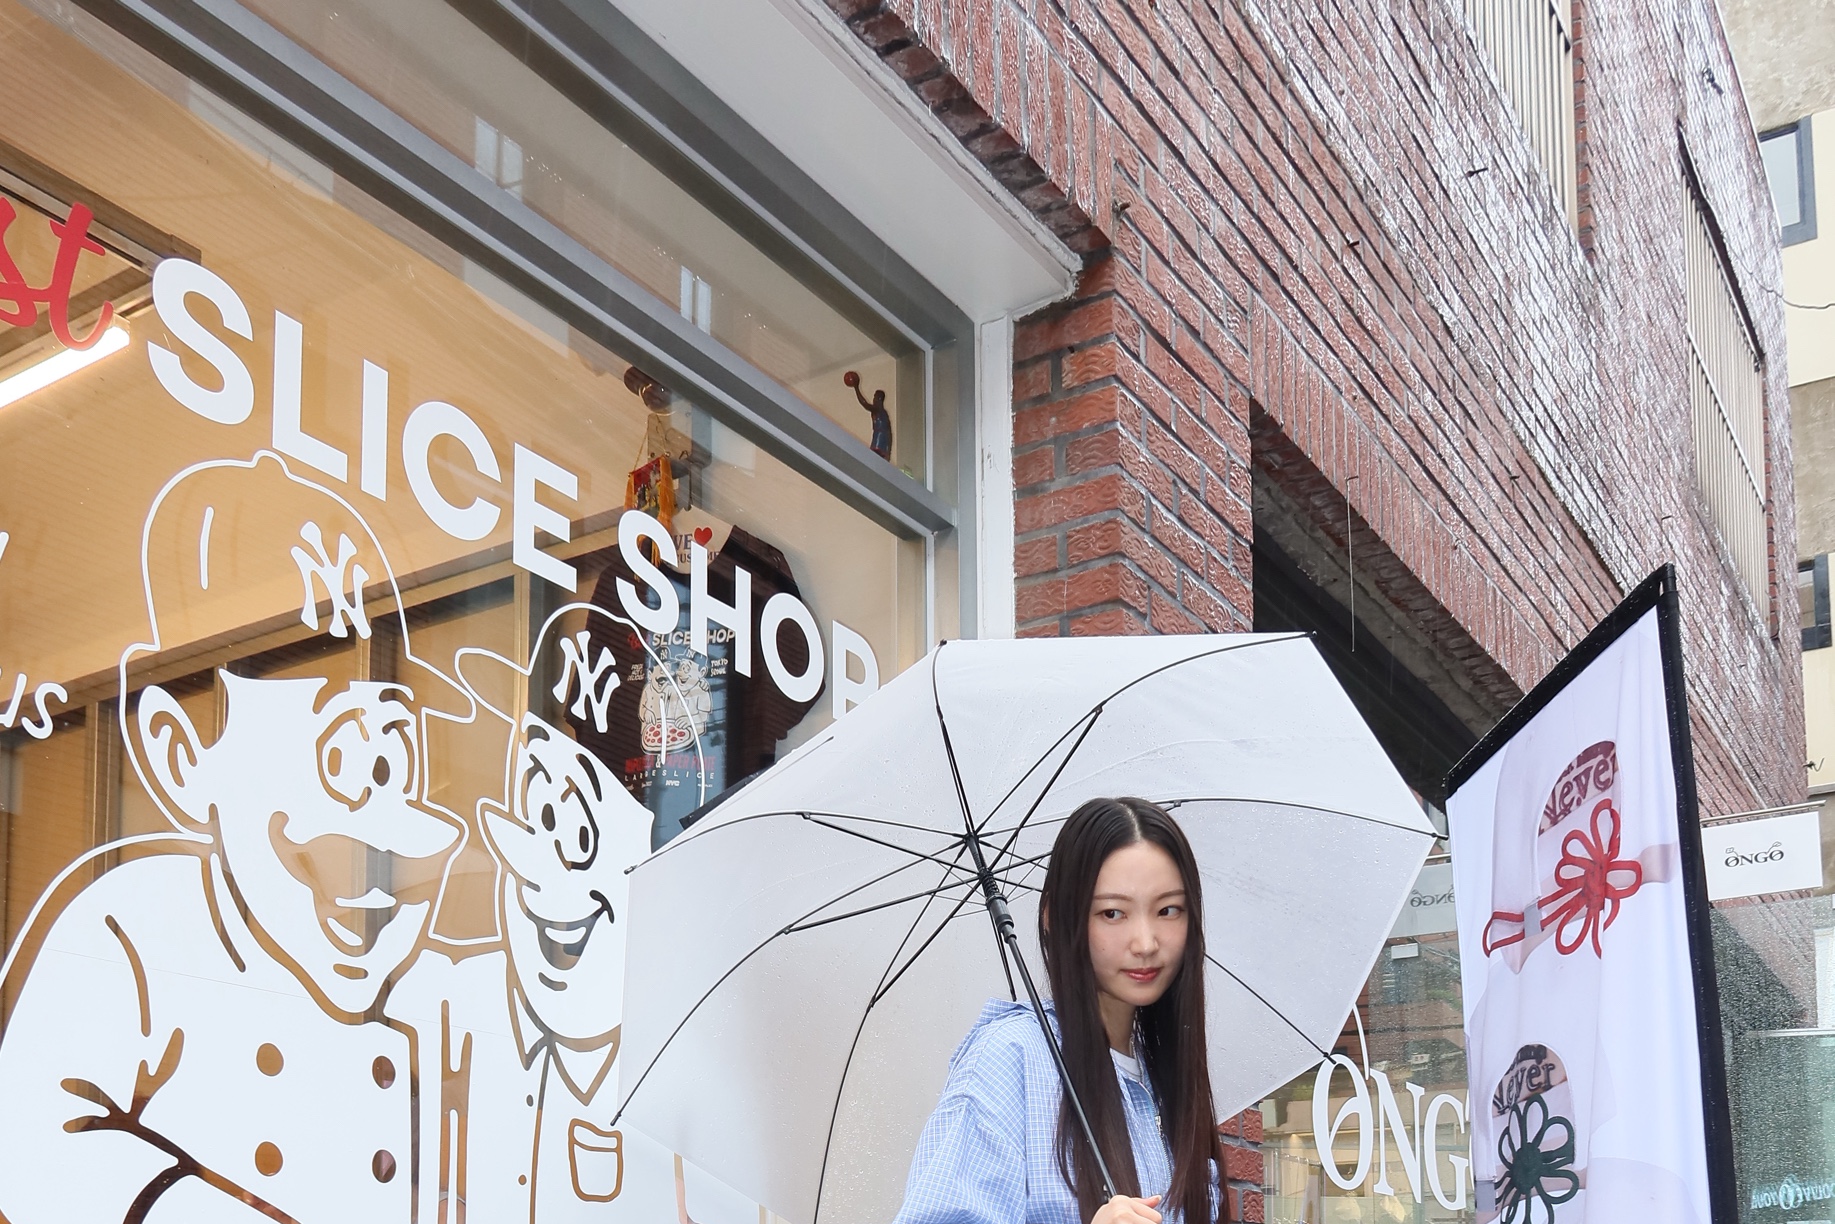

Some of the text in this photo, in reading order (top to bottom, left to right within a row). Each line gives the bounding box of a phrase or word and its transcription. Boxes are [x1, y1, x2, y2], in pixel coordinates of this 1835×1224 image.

[146, 257, 579, 591] SLICE
[615, 509, 880, 720] SHOP
[707, 628, 735, 644] HOP
[1312, 1053, 1475, 1211] ONG
